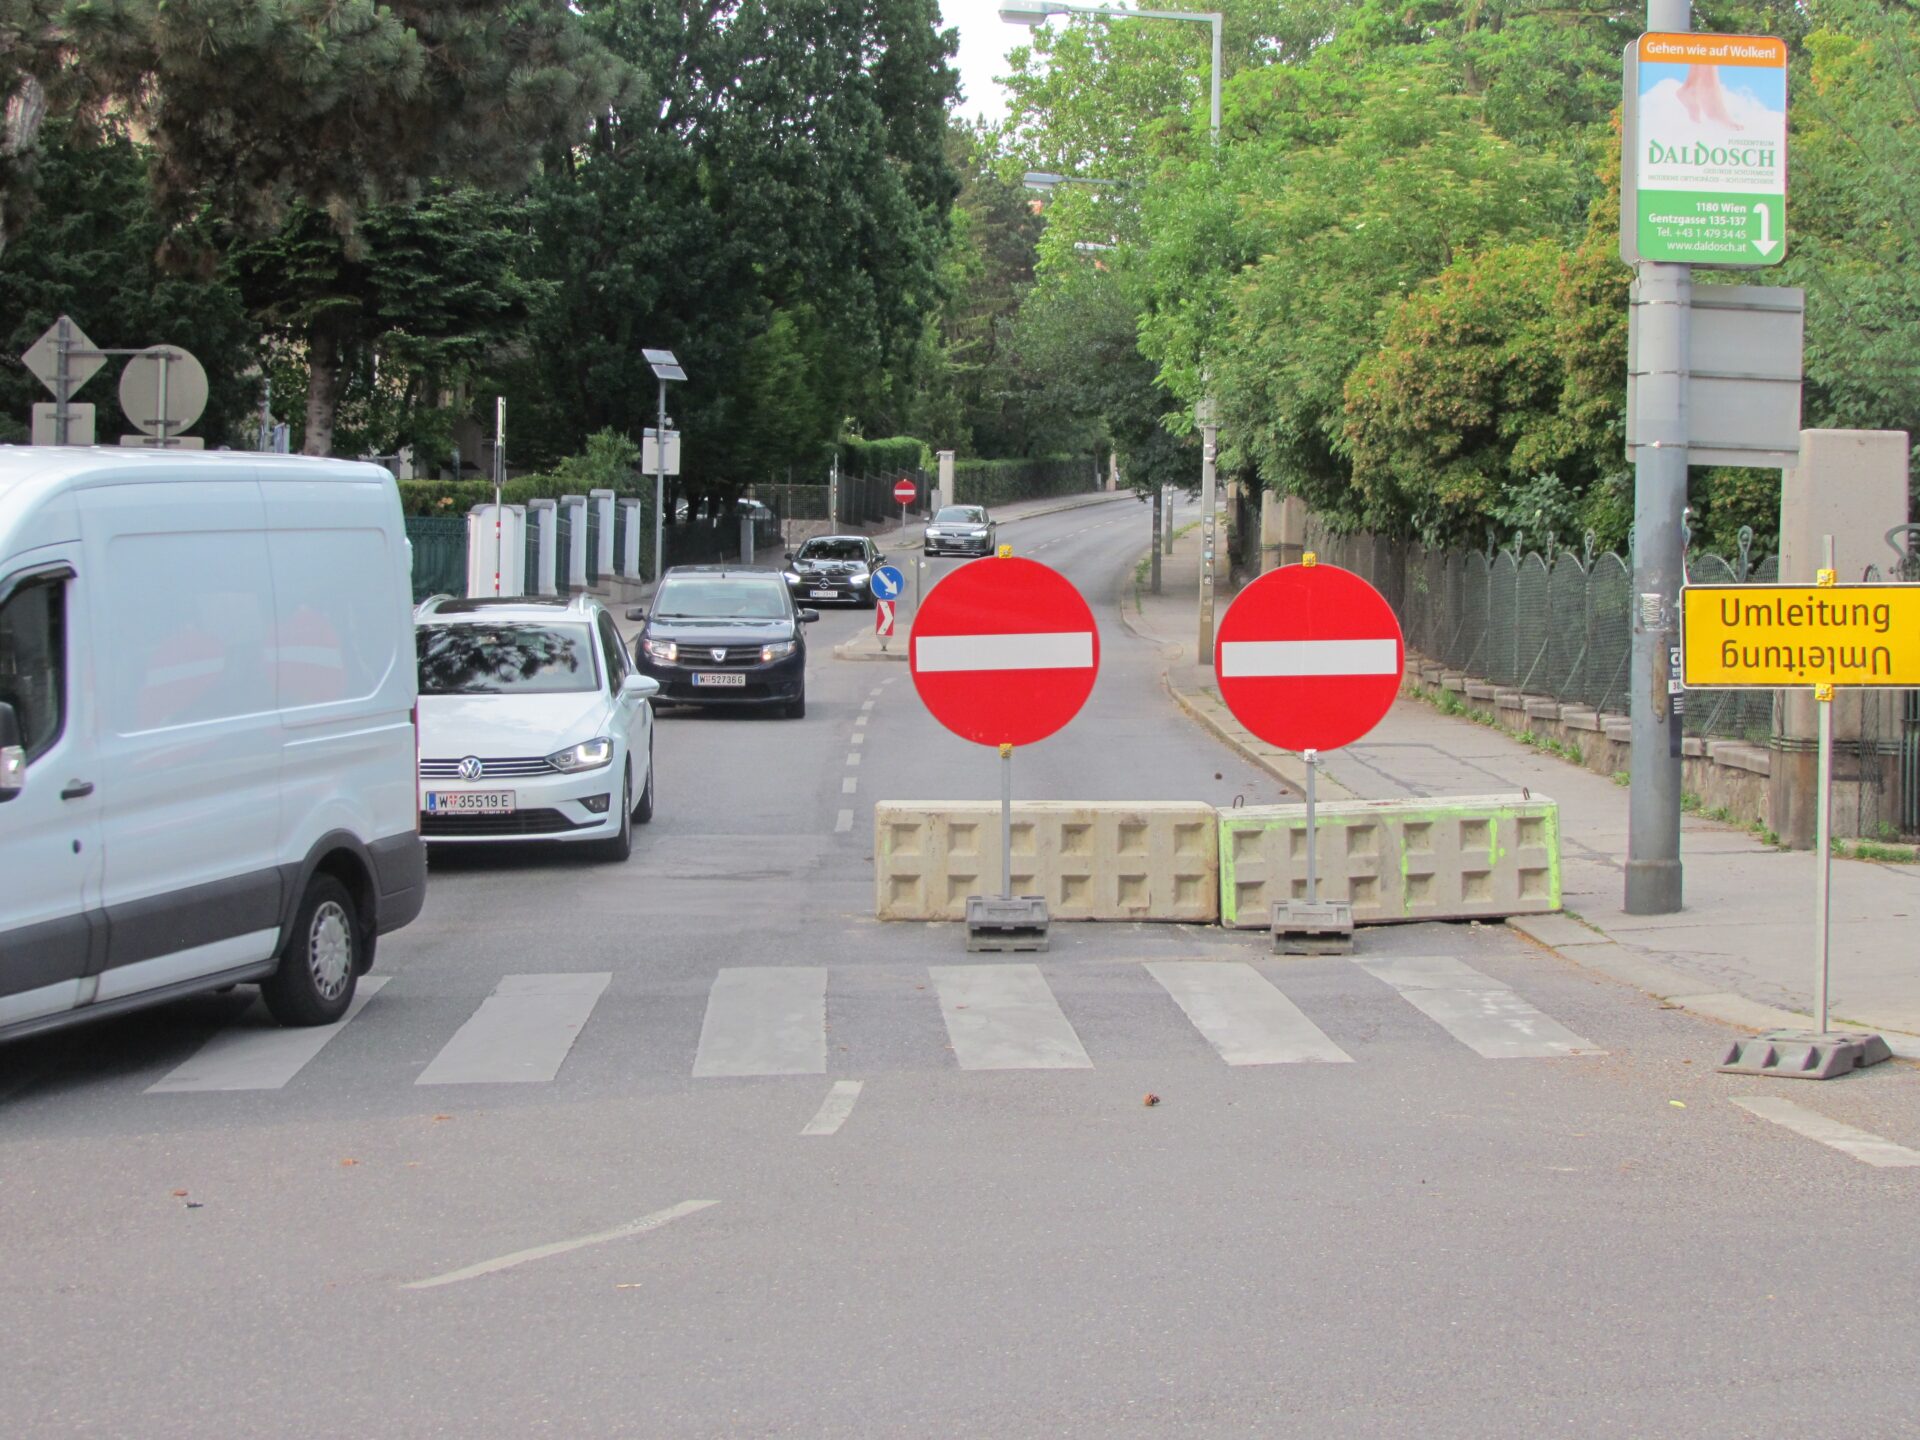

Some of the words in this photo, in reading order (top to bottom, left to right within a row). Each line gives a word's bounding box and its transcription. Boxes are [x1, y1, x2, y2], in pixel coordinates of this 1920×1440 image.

[1646, 42, 1683, 55] Gehen
[1687, 44, 1706, 55] wie
[1709, 45, 1728, 56] auf
[1730, 45, 1776, 59] Wolken!
[1648, 138, 1776, 167] DALDOSCH
[1696, 202, 1718, 212] 1180
[1721, 203, 1747, 213] Wien
[1648, 213, 1706, 226] Gentzgasse
[1709, 215, 1747, 226] 135-137
[1657, 227, 1672, 237] Tel.
[1675, 228, 1693, 238] +43
[1704, 229, 1721, 238] 479
[1722, 229, 1734, 239] 34
[1735, 230, 1747, 239] 45
[1667, 241, 1747, 252] www.daldosch.at
[1720, 595, 1891, 633] Umleitung
[1721, 639, 1891, 677] Umleitung
[439, 796, 449, 808] W
[459, 795, 498, 808] 35519
